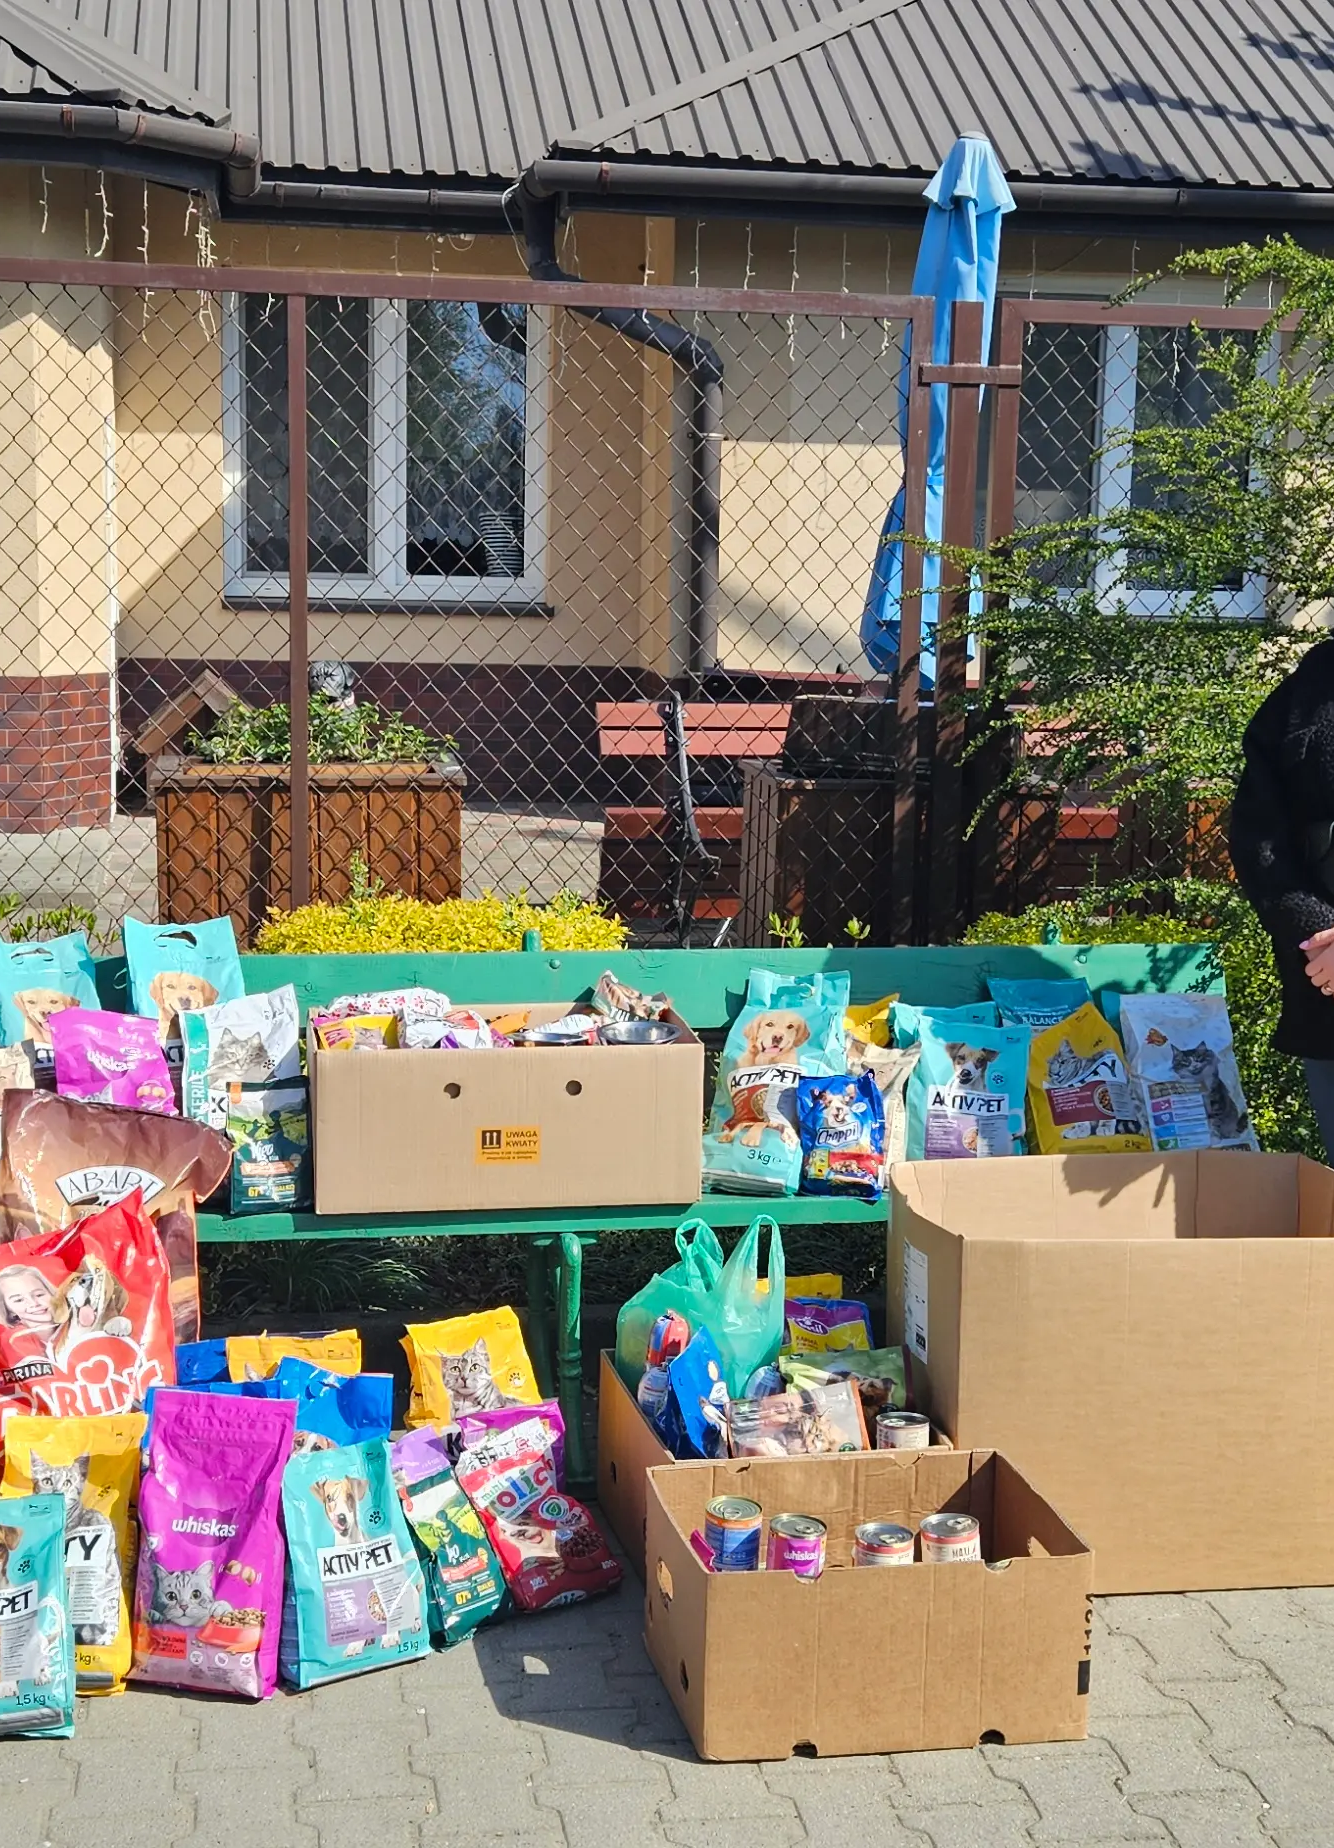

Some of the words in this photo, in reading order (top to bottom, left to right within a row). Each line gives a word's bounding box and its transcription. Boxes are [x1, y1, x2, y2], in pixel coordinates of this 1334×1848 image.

[730, 1071, 767, 1093] ACTIV
[769, 1067, 801, 1084] PET
[976, 1094, 1006, 1113] PET
[747, 1149, 756, 1160] 3
[757, 1151, 771, 1165] kg
[68, 1170, 159, 1198] ABART
[3, 1362, 53, 1385] PURINA
[172, 1516, 236, 1538] whiskas
[323, 1552, 359, 1577] ACTIV
[360, 1542, 393, 1569] PET
[33, 1693, 46, 1706] kg
